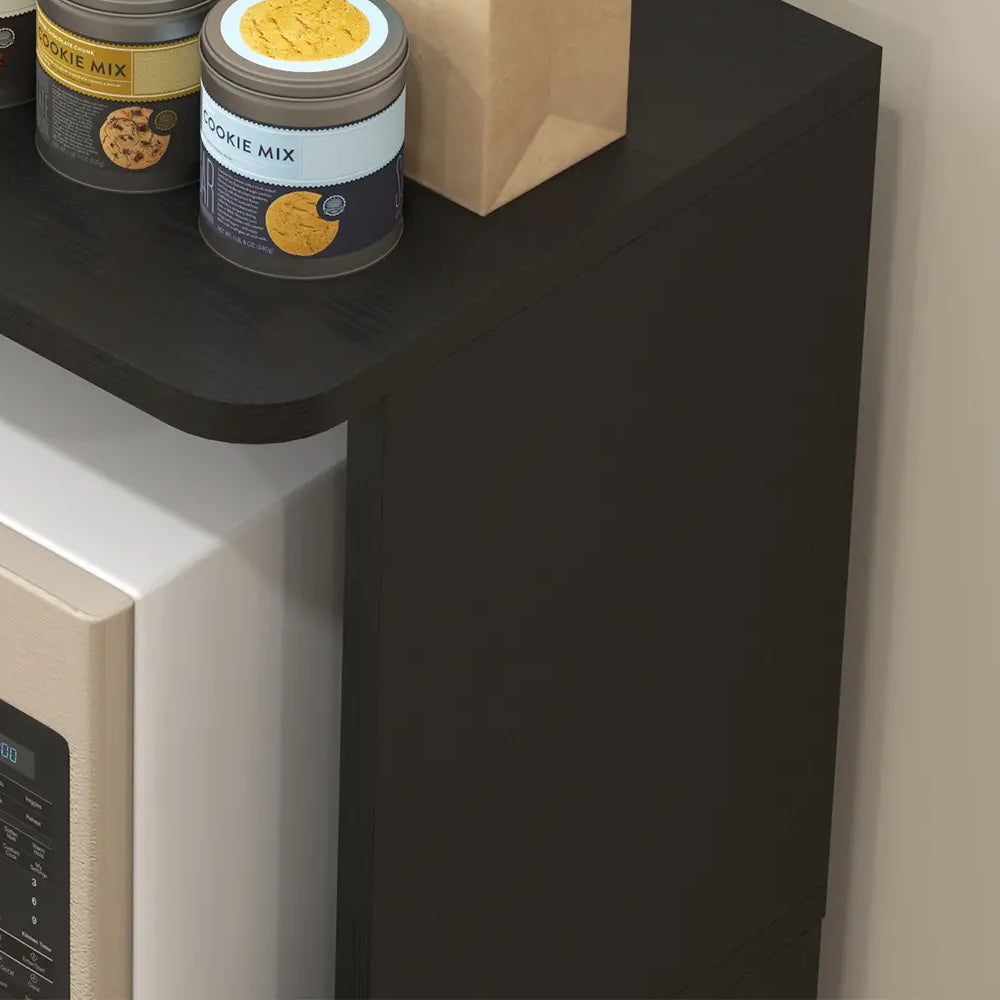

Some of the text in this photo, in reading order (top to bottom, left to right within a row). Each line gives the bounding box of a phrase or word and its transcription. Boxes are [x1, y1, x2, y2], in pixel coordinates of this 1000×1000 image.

[90, 60, 127, 78] MIX
[203, 109, 252, 154] COOKIE
[258, 144, 295, 162] MIX
[31, 878, 37, 887] 3
[31, 897, 37, 906] 6
[31, 915, 37, 925] 9
